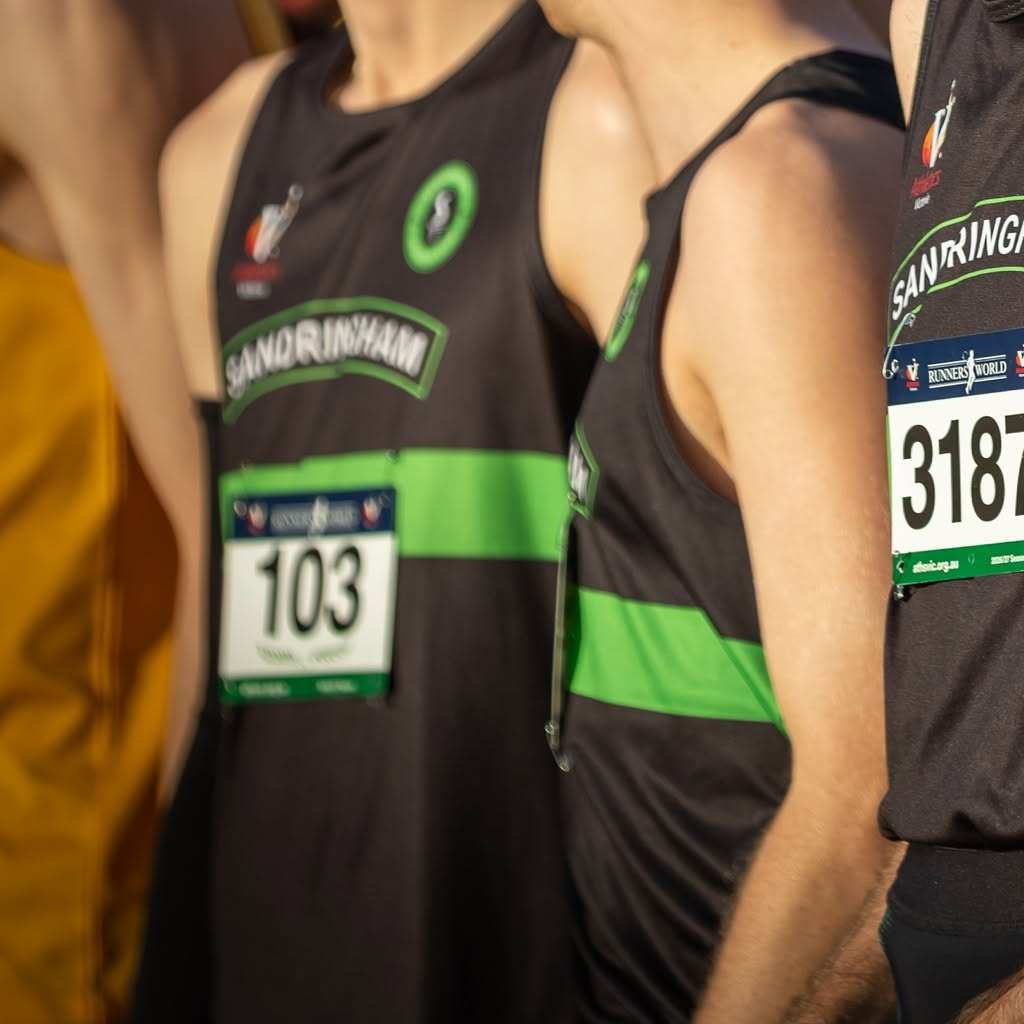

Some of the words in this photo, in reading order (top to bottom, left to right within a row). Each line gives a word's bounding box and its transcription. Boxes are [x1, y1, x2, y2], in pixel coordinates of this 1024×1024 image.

[927, 365, 969, 384] RUNNERS
[974, 360, 1007, 375] WORLD
[256, 544, 361, 636] 103
